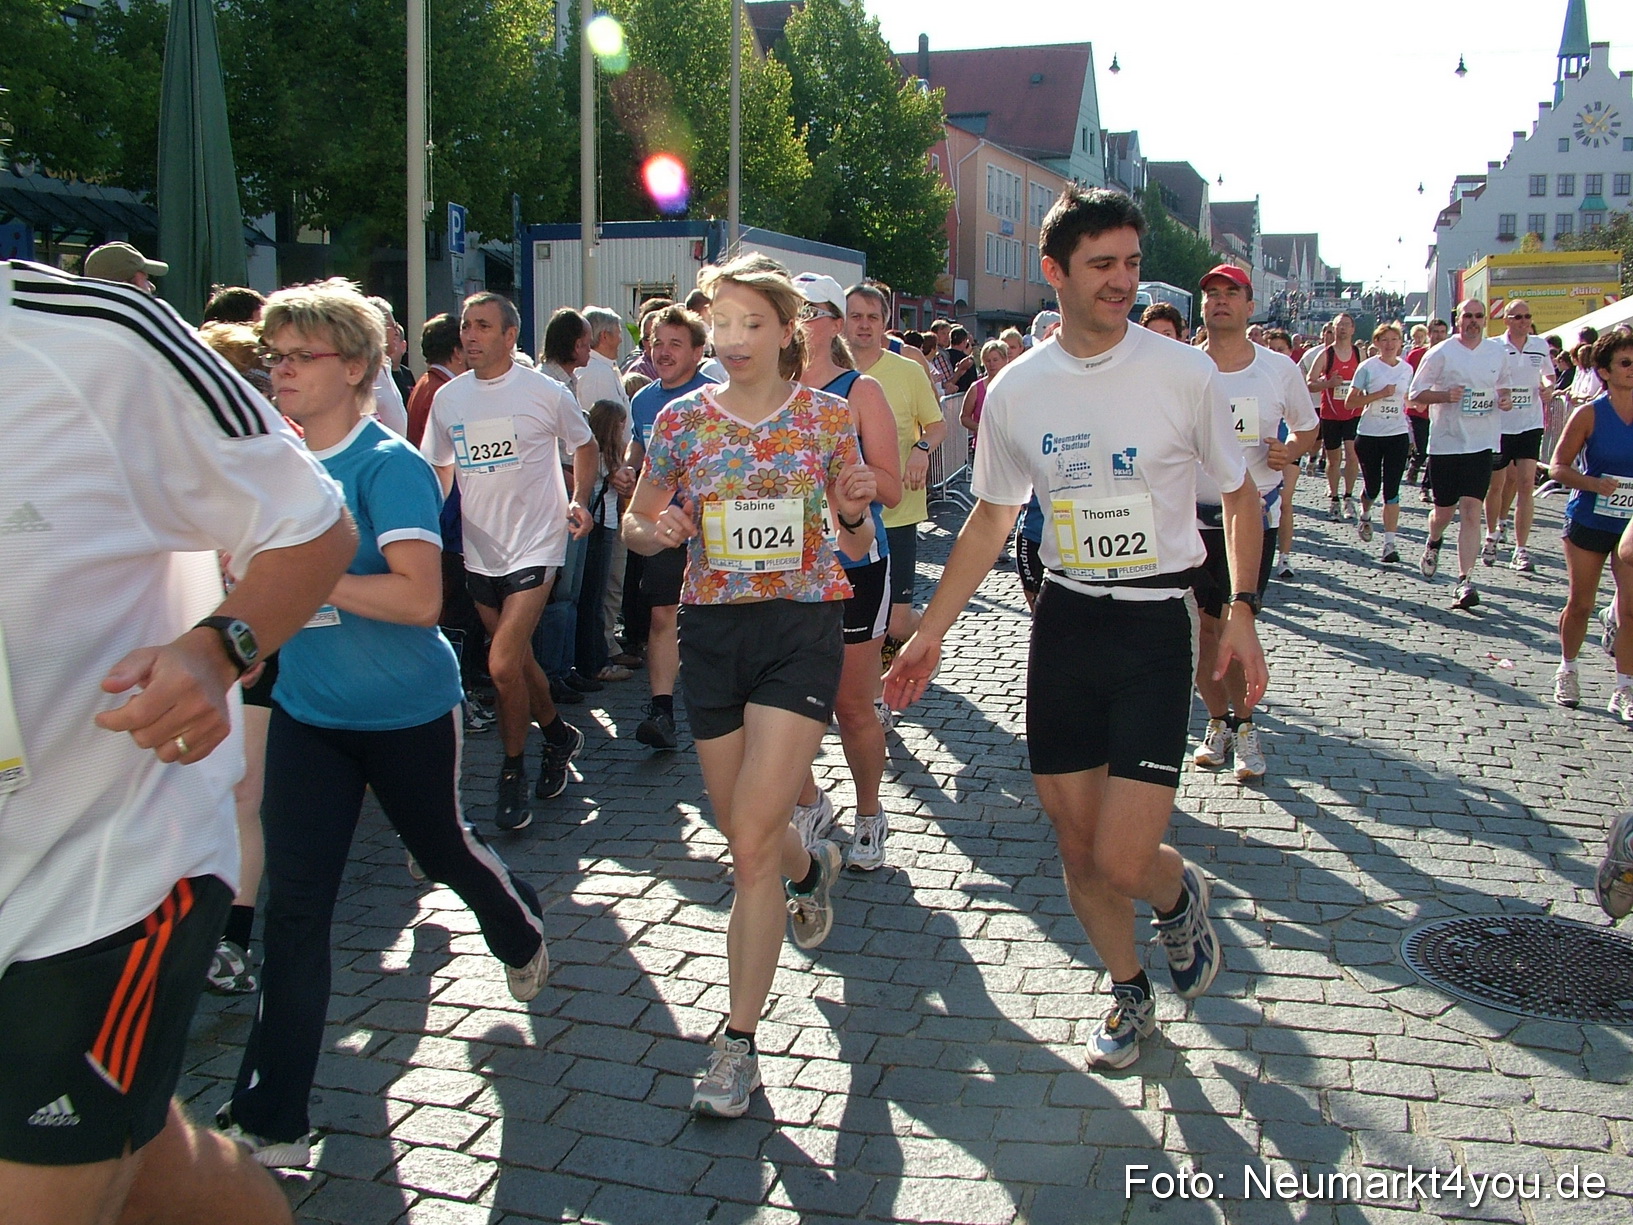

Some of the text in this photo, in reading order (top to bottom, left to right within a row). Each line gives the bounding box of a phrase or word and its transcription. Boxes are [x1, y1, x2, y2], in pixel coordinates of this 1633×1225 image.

[452, 210, 461, 246] P
[1511, 395, 1531, 404] 2231
[1380, 405, 1399, 415] 3548
[1053, 433, 1091, 445] Neumarkter
[470, 440, 514, 461] 2322
[1060, 441, 1091, 452] Stadtlauf
[734, 501, 776, 511] Sabine
[1081, 508, 1131, 520] Thomas
[732, 526, 795, 550] 1024
[1083, 532, 1148, 558] 1022
[1118, 563, 1158, 575] PFLEIDERER
